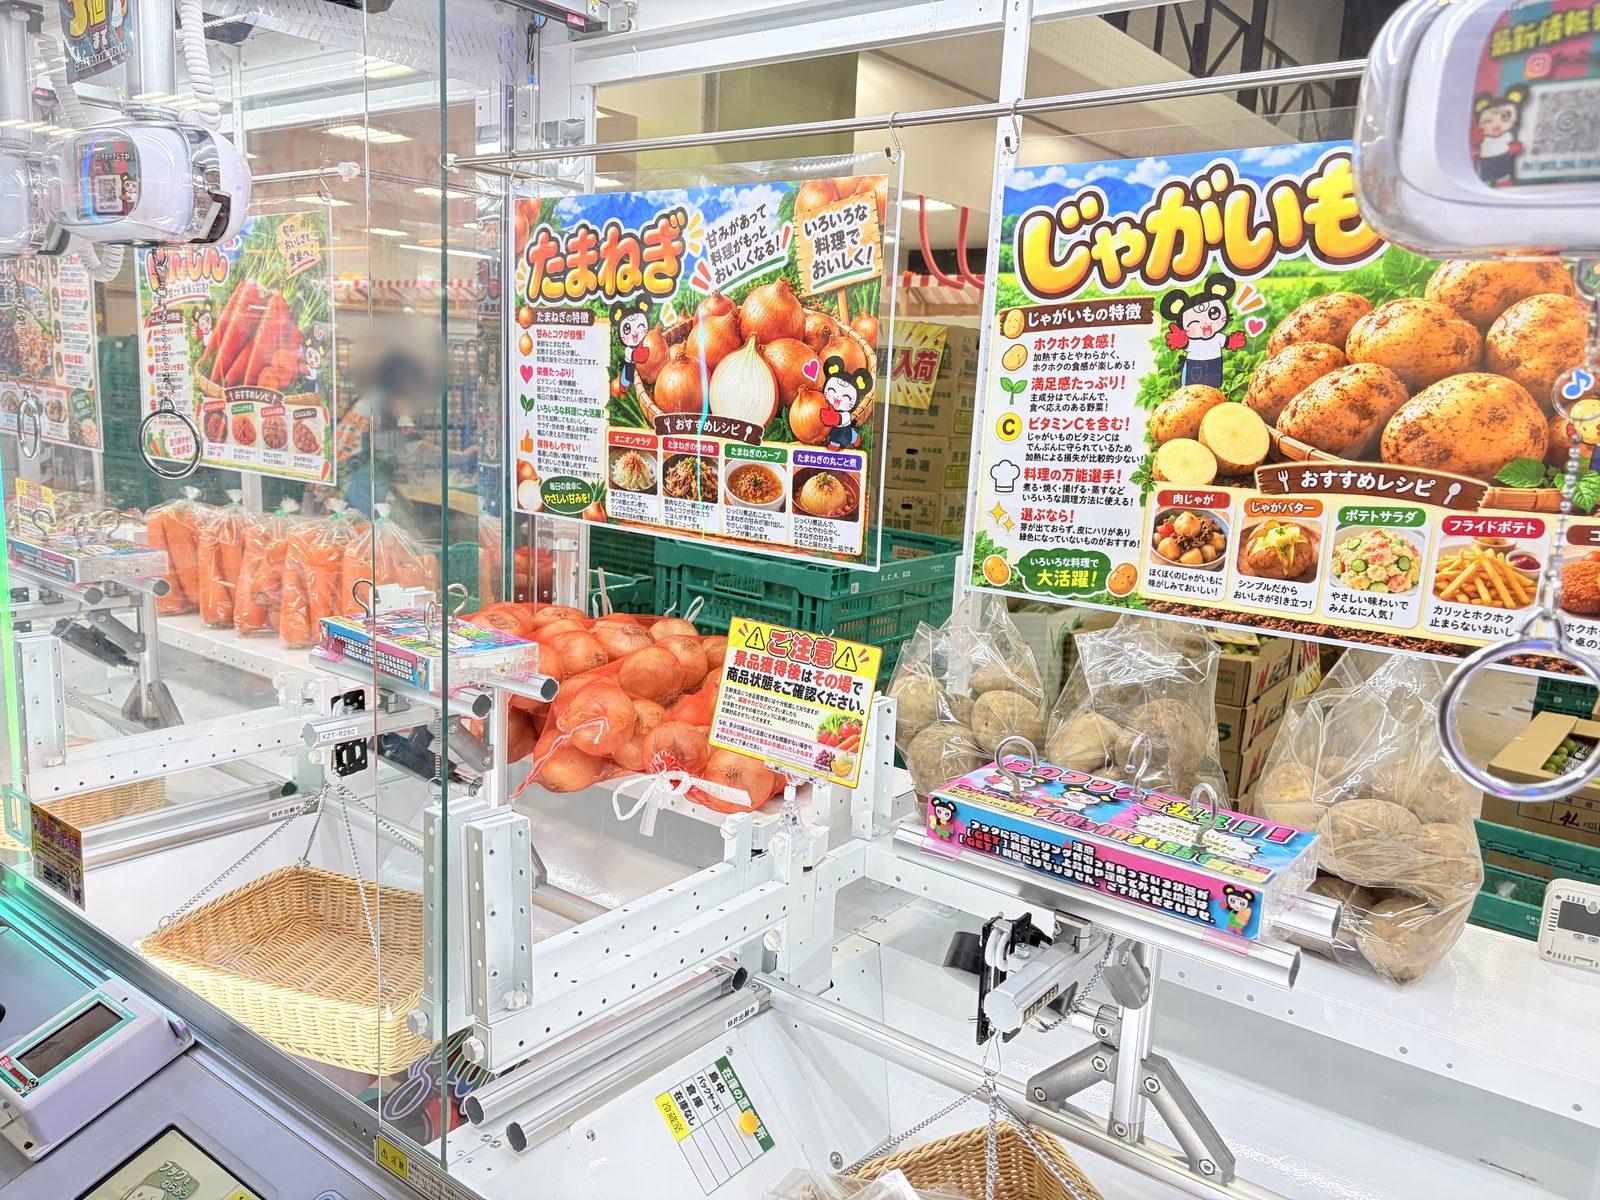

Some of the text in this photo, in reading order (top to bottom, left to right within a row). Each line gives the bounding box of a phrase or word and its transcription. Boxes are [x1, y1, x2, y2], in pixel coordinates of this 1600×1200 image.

[706, 203, 767, 249] 甘みがあって
[804, 203, 868, 235] いろいろな
[1017, 152, 1387, 298] じゃがいも
[710, 228, 768, 265] 料理がもっと
[814, 229, 861, 255] 料理で
[527, 210, 689, 299] たまねぎ
[714, 239, 781, 284] おいしくなる!
[812, 246, 873, 280] おいしく!
[536, 311, 590, 324] たまねぎの特徴
[1028, 302, 1142, 328] じゃがいもの特徴
[536, 329, 586, 341] 甘みとコクが自慢!
[1033, 334, 1116, 351] ホクホク食感!
[1033, 351, 1120, 362] 加熱するとやわらかく、
[536, 366, 575, 378] 栄養たっぷり!
[1032, 361, 1136, 372] ホクホクの食感が楽しめる!
[1031, 375, 1126, 391] 満足感たっぷり!
[1030, 393, 1108, 402] 主成分はでんぷんで、
[536, 404, 605, 418] いろいろな料理に大活躍!
[1029, 402, 1109, 413] 食べ応えのある野菜!
[675, 417, 742, 436] おすすめレシピ
[1028, 417, 1130, 431] ビタミンCを含む!
[614, 435, 652, 447] オニオンサラダ
[1027, 432, 1120, 442] じゃがいものビタミンCは
[536, 439, 582, 452] 保存もしやすい!
[730, 447, 781, 460] たまねぎのスープ
[1026, 442, 1133, 453] でんぷんに守られているため
[797, 453, 857, 468] たまねぎの丸ごと煮
[1025, 452, 1144, 464] 加熱による損失が比較的少ない!
[1024, 467, 1122, 484] 料理の万能選手!
[1301, 470, 1437, 497] おすすめレシピ
[549, 481, 582, 491] 毎日の食卓に
[1022, 483, 1126, 496] 煮る・焼く・揚げる・蒸すなど
[543, 492, 591, 504] やさしい甘みを!
[1022, 493, 1134, 507] いろいろな調理方法に使える!
[1172, 492, 1215, 506] 肉じゃが
[1020, 507, 1075, 524] 選ぶなら!
[1250, 501, 1316, 514] じゃがバター
[1345, 510, 1418, 524] ポテトサラダ
[726, 522, 764, 533] やさしい味わいの
[1020, 523, 1131, 537] 芽が出ておらず、皮にハリがあり
[1450, 520, 1537, 535] フライドポテト
[793, 532, 834, 543] たまねぎの甘みを
[1019, 532, 1141, 548] 緑色になっていないものがおすすめ!
[793, 539, 857, 554] まるごと味わえる一品です。
[1029, 556, 1100, 569] いろいろな料理で
[1036, 568, 1099, 589] 大活躍!
[1149, 568, 1223, 586] ほくほくのじゃがいもに
[1148, 578, 1219, 597] 味がしみておいしい!
[1237, 579, 1299, 596] シンプルだから
[1233, 590, 1313, 610] おいしさが引き立つ!
[1330, 591, 1409, 611] やさしい味わいで
[1328, 603, 1394, 621] みんなに人気!
[1433, 605, 1514, 625] カリッとホクホク
[1429, 618, 1519, 637] 止まらないおいし
[1565, 622, 1600, 638] ホクホ
[767, 629, 838, 669] ご注意
[733, 650, 864, 696] 景品獲得後はその場で
[726, 667, 865, 715] 商品状態をご確認ください。
[322, 729, 356, 740] KZT-R250
[726, 1006, 756, 1029] 特許出願中
[708, 1071, 726, 1094] 島中
[685, 1084, 704, 1109] 倉庫
[696, 1075, 722, 1112] バックヤード
[673, 1090, 695, 1127] 在庫なし
[721, 1066, 768, 1141] 在庫の置所
